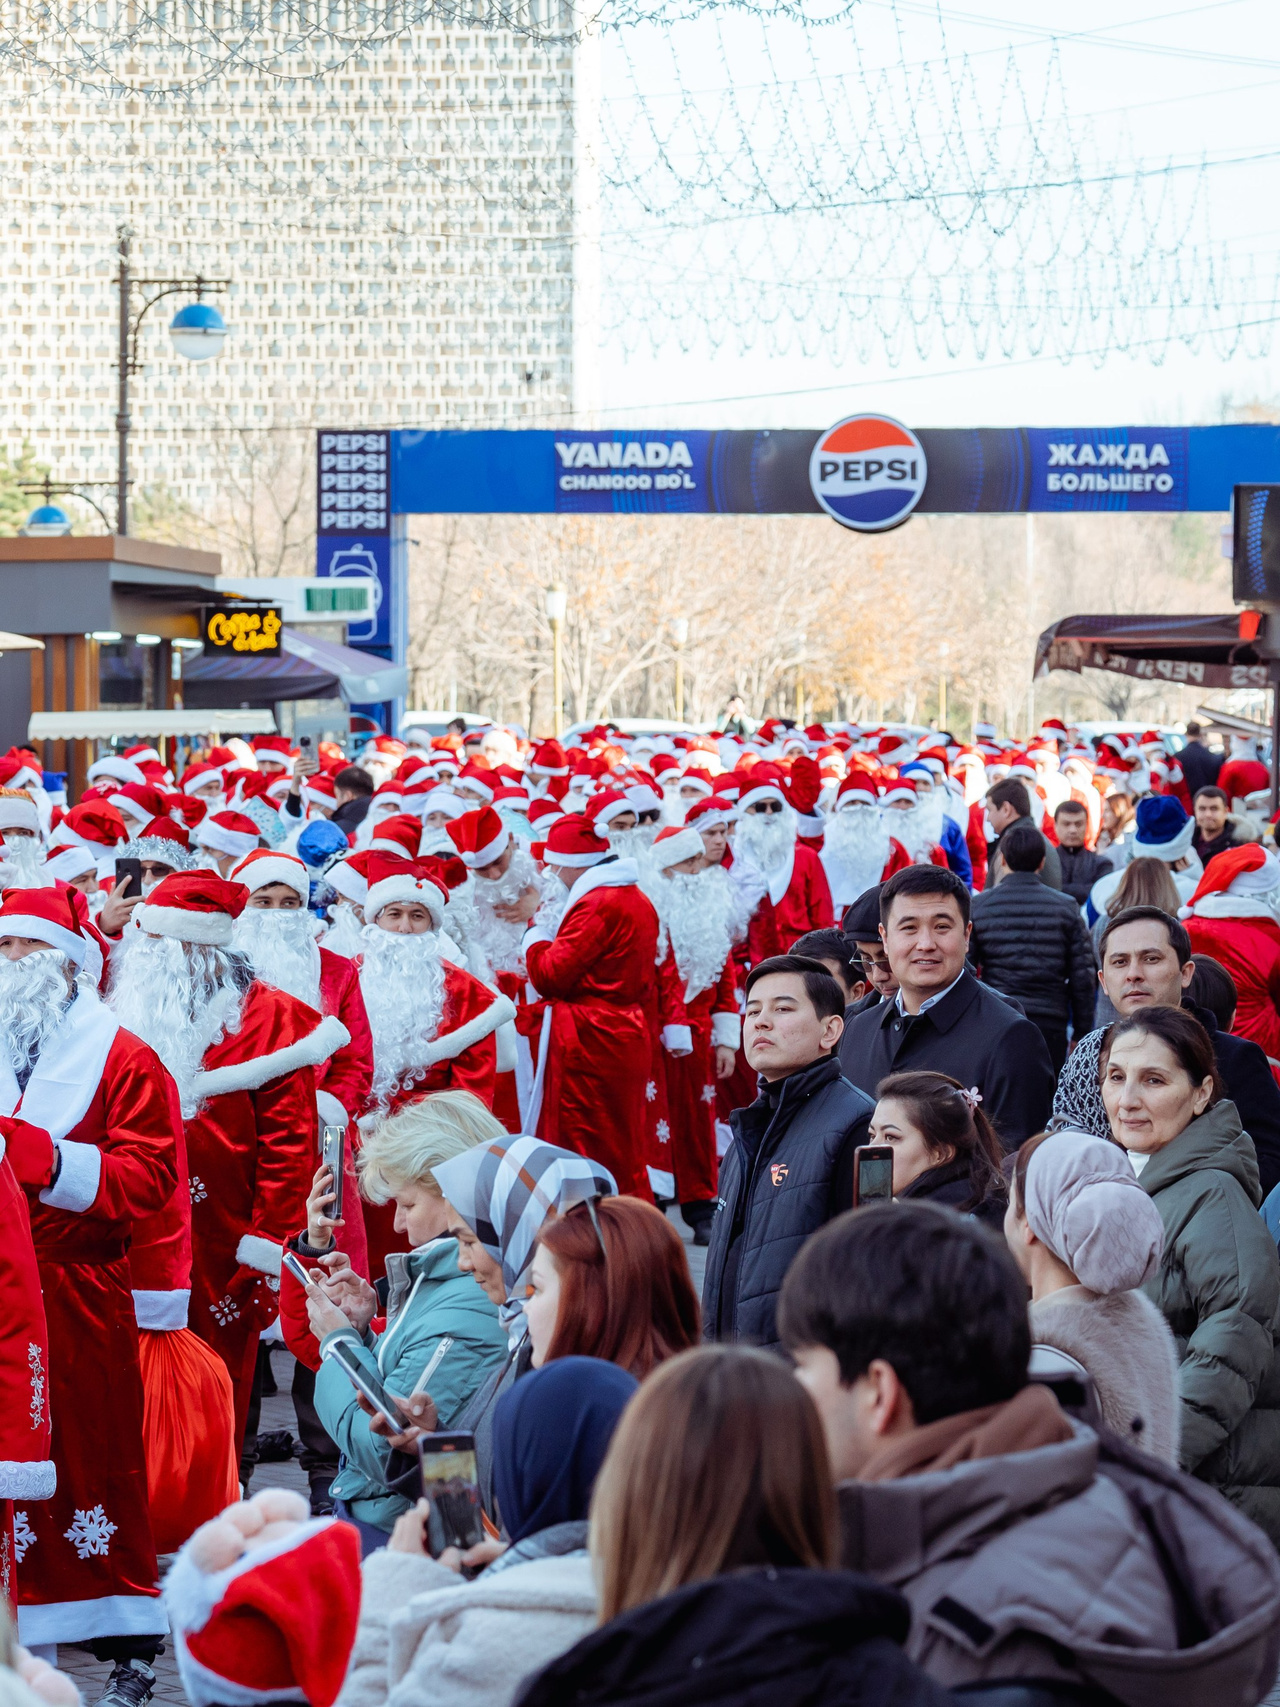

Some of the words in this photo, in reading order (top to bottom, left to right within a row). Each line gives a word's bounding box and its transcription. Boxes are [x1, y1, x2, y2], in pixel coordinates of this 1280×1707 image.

[321, 434, 387, 452] PEPSI
[321, 453, 387, 471] PEPSI
[554, 441, 694, 468] YANADA
[1047, 443, 1170, 470] ЖАЖДА
[820, 459, 917, 481] PEPSI
[321, 472, 387, 491] PEPSI
[1047, 472, 1174, 493] БОЛЬШЕГО
[321, 492, 387, 510] PEPSI
[321, 511, 387, 529] PEPSI
